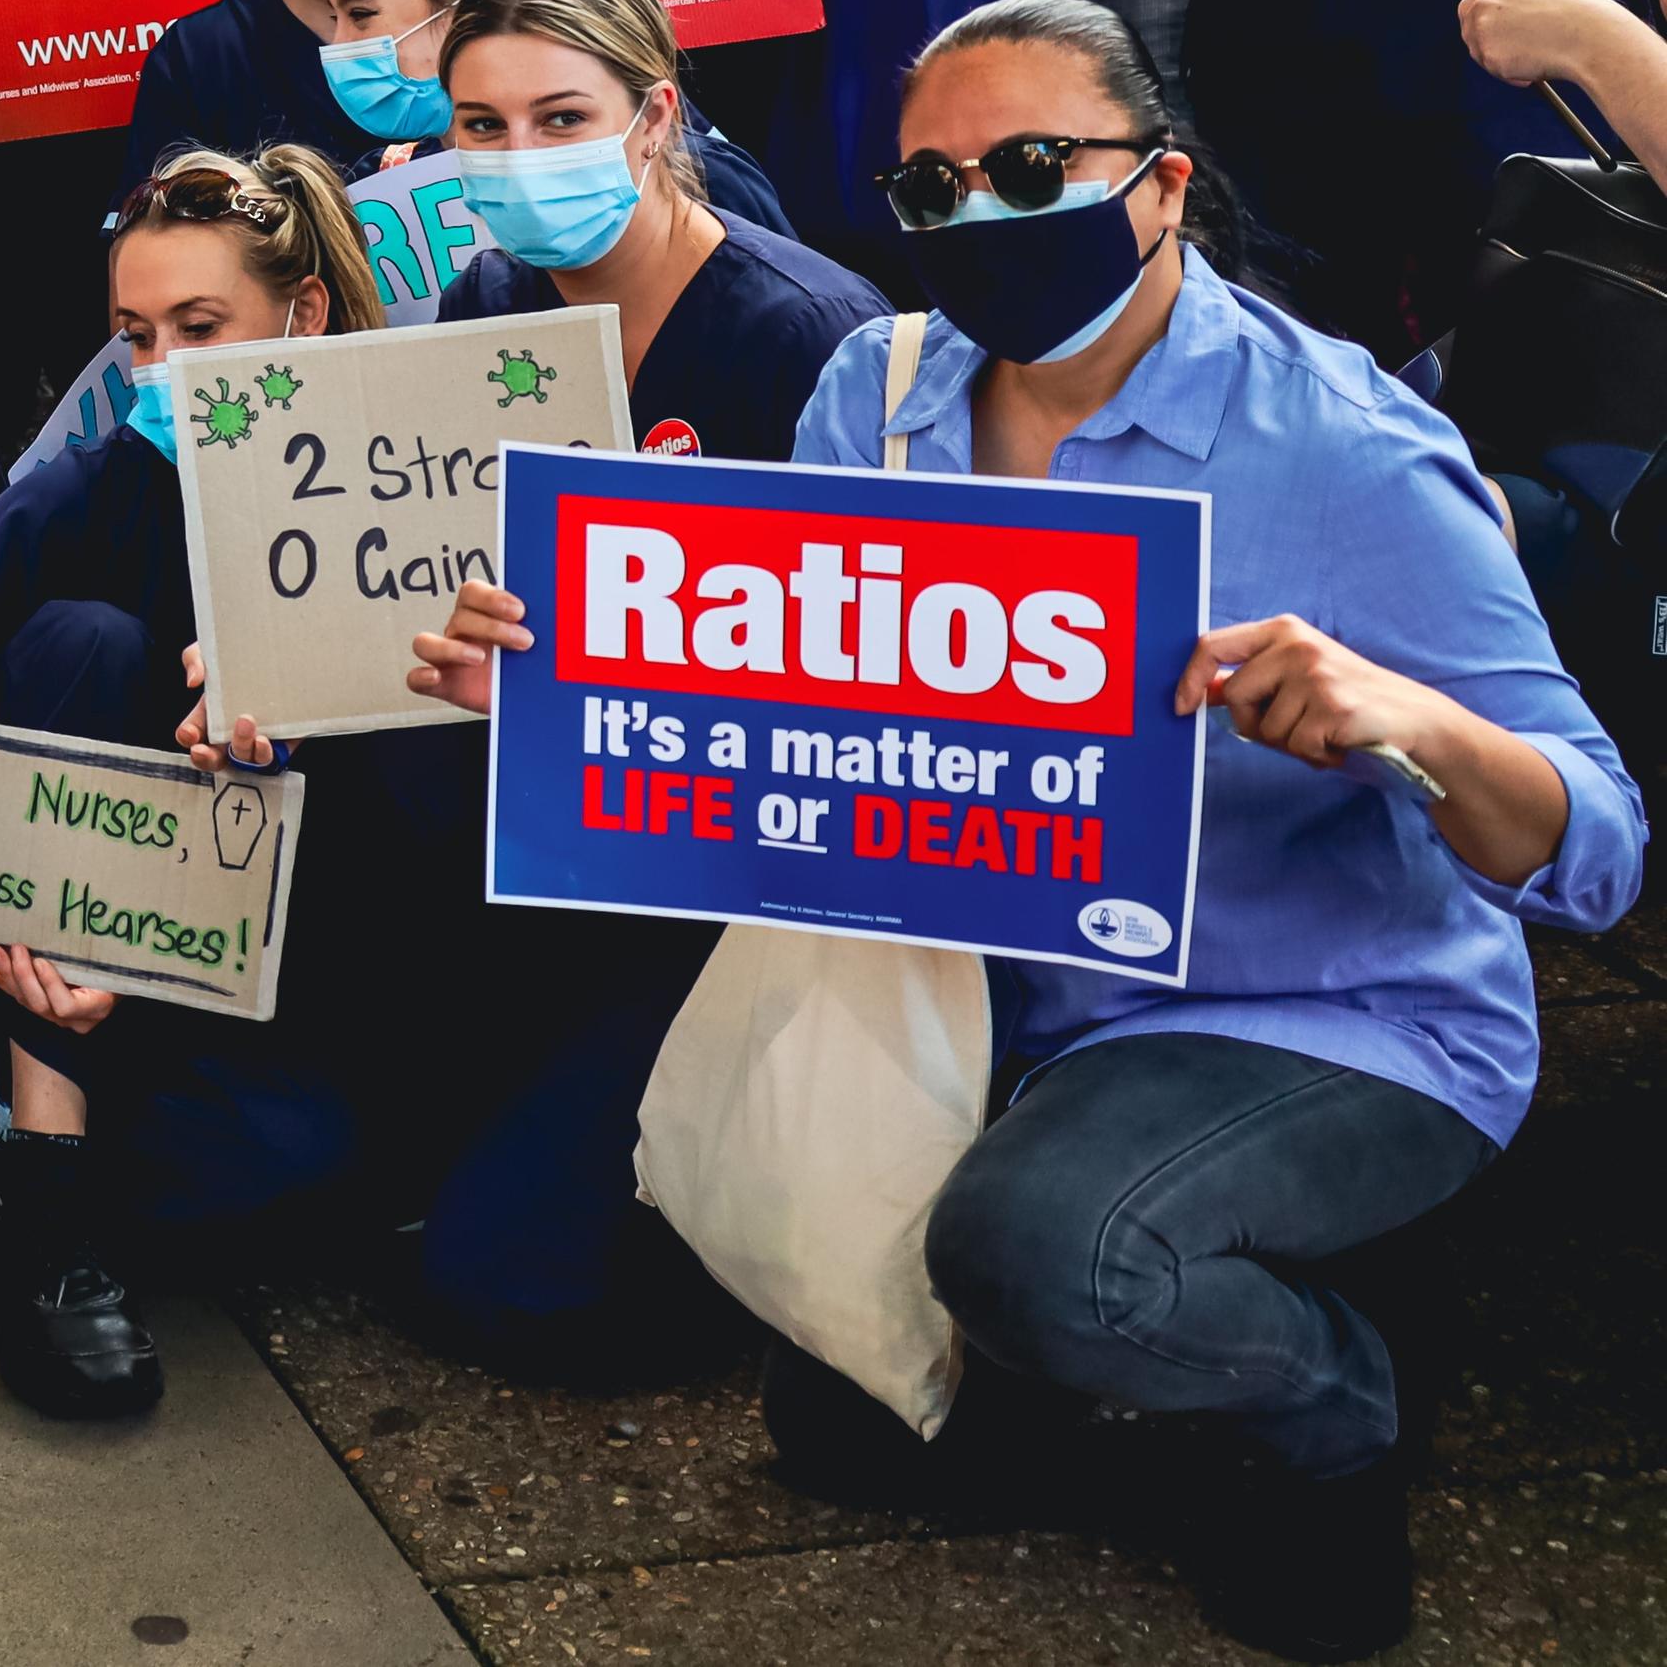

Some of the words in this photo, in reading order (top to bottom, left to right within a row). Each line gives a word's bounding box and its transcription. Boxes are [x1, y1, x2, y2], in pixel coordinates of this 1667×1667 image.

[22, 85, 38, 96] and
[283, 434, 345, 500] 2
[356, 529, 495, 601] Gain
[583, 522, 1107, 704] Ratios
[583, 697, 686, 762] It's
[708, 721, 746, 770] a
[772, 728, 1009, 796] matter
[1030, 747, 1105, 806] of
[28, 773, 189, 863] Nurses,
[583, 765, 733, 841] LIFE
[758, 792, 829, 853] or
[854, 795, 1102, 884] DEATH
[57, 876, 249, 972] Hearses!
